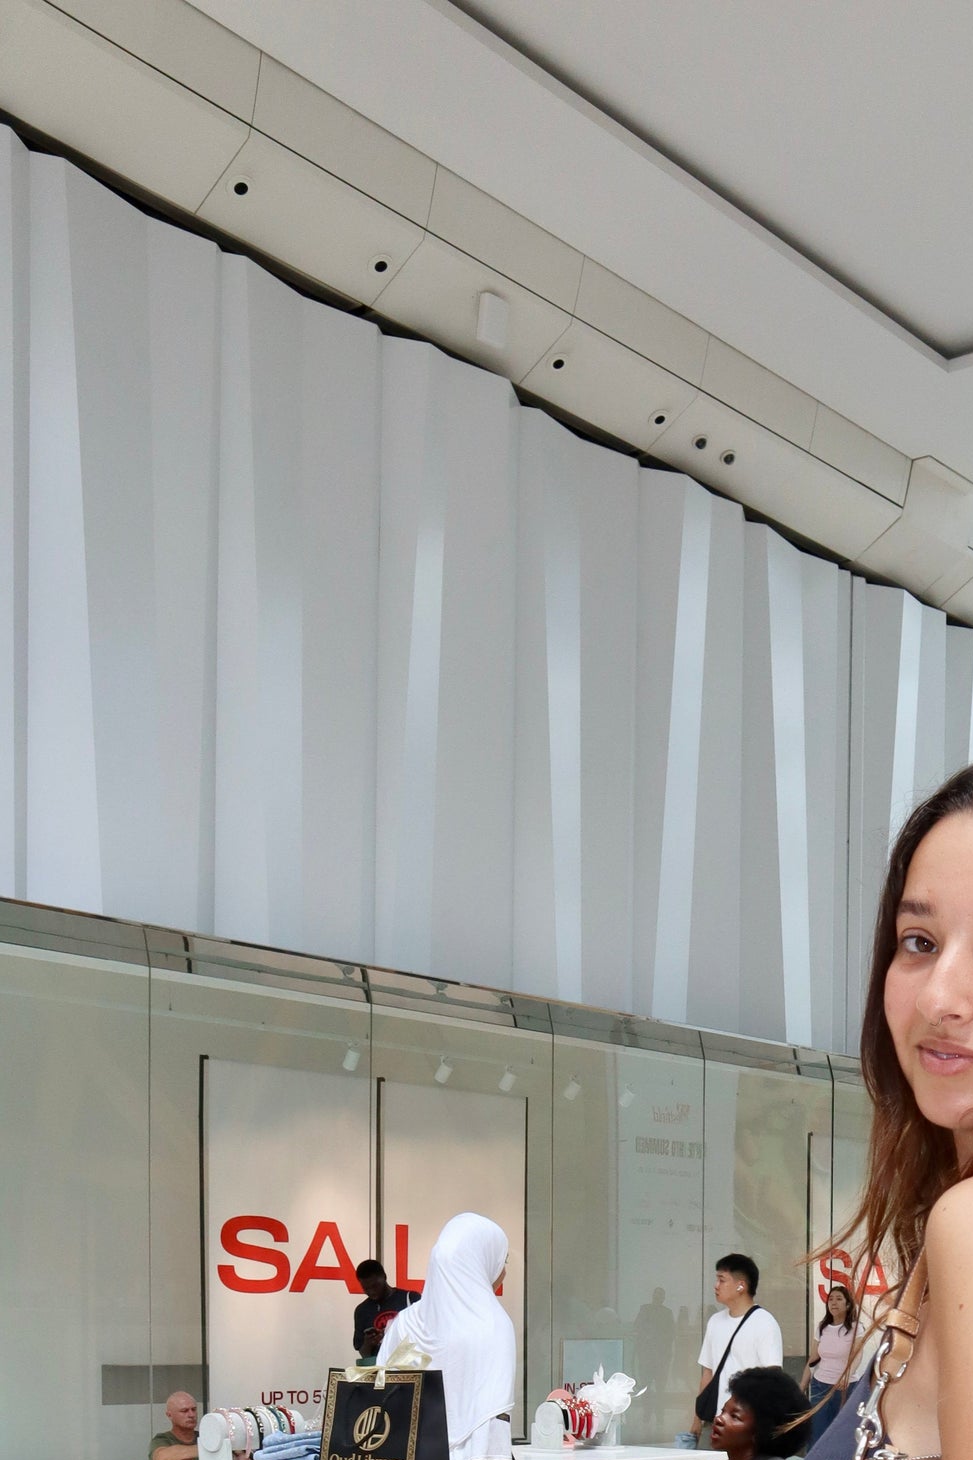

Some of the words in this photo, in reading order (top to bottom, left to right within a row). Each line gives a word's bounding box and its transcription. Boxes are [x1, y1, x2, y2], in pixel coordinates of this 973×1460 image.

[217, 1215, 503, 1296] SAL
[261, 1391, 284, 1405] UP
[287, 1390, 309, 1404] TO
